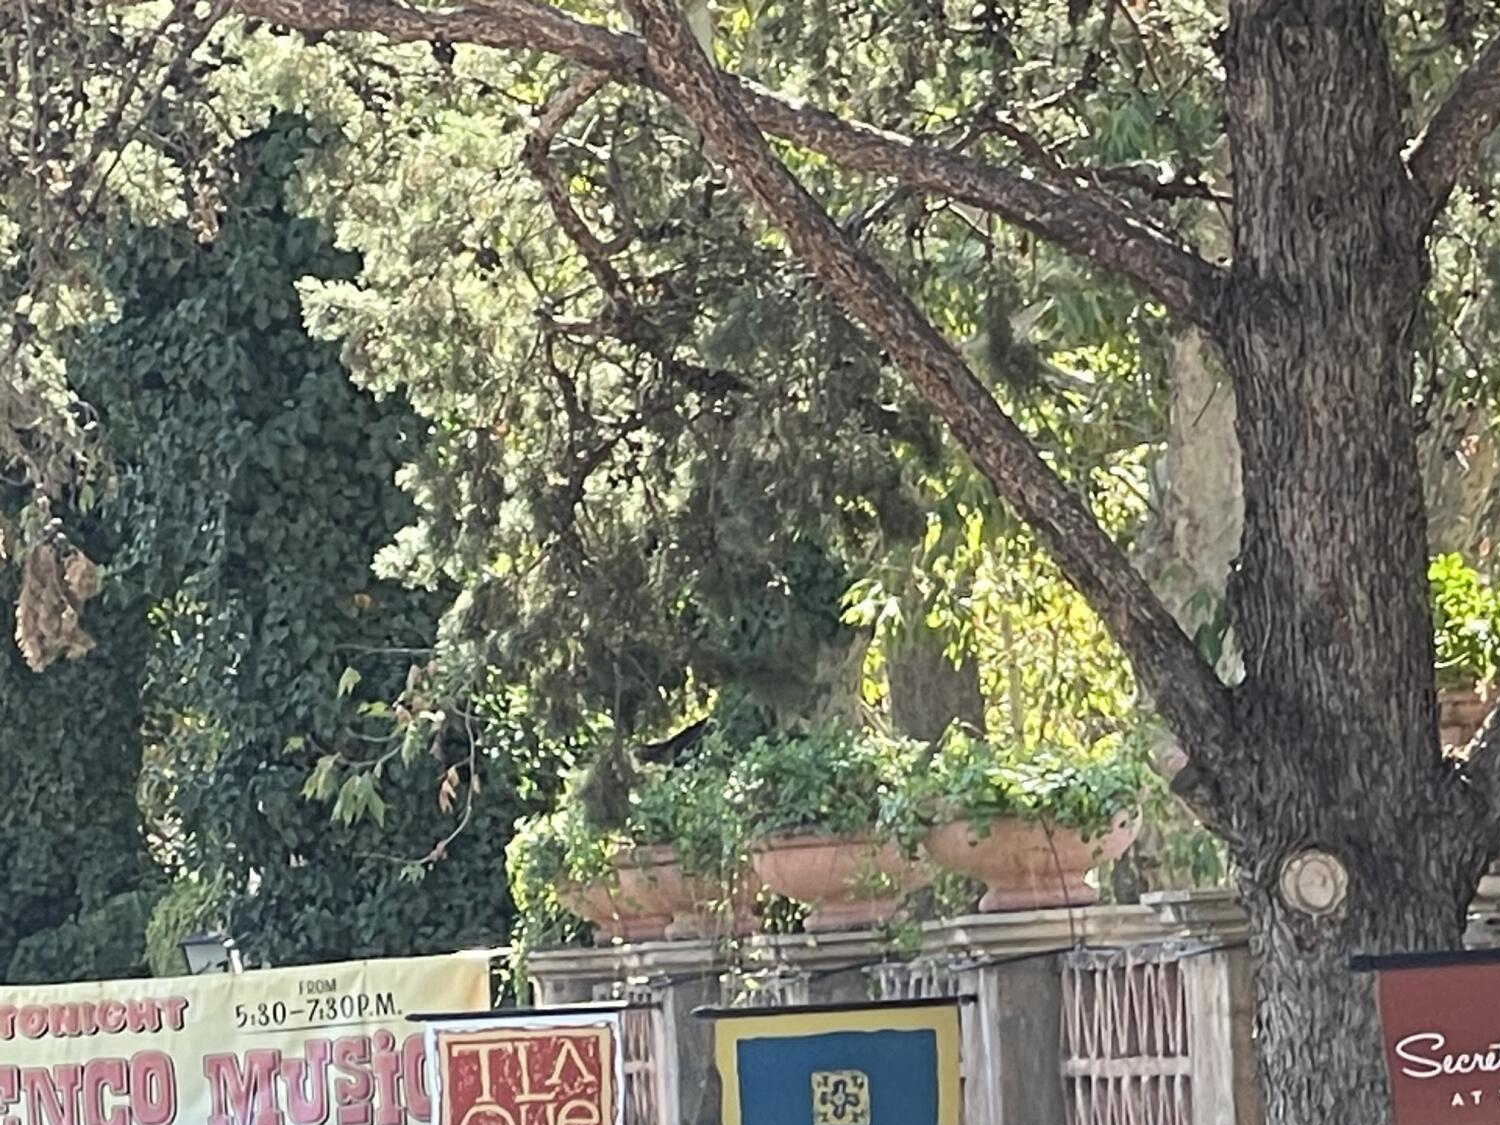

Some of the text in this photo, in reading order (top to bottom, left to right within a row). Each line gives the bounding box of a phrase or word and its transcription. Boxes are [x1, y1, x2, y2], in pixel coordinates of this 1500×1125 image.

[299, 979, 337, 995] FROM
[0, 996, 189, 1040] TONIGHT
[1451, 1090, 1483, 1107] AT
